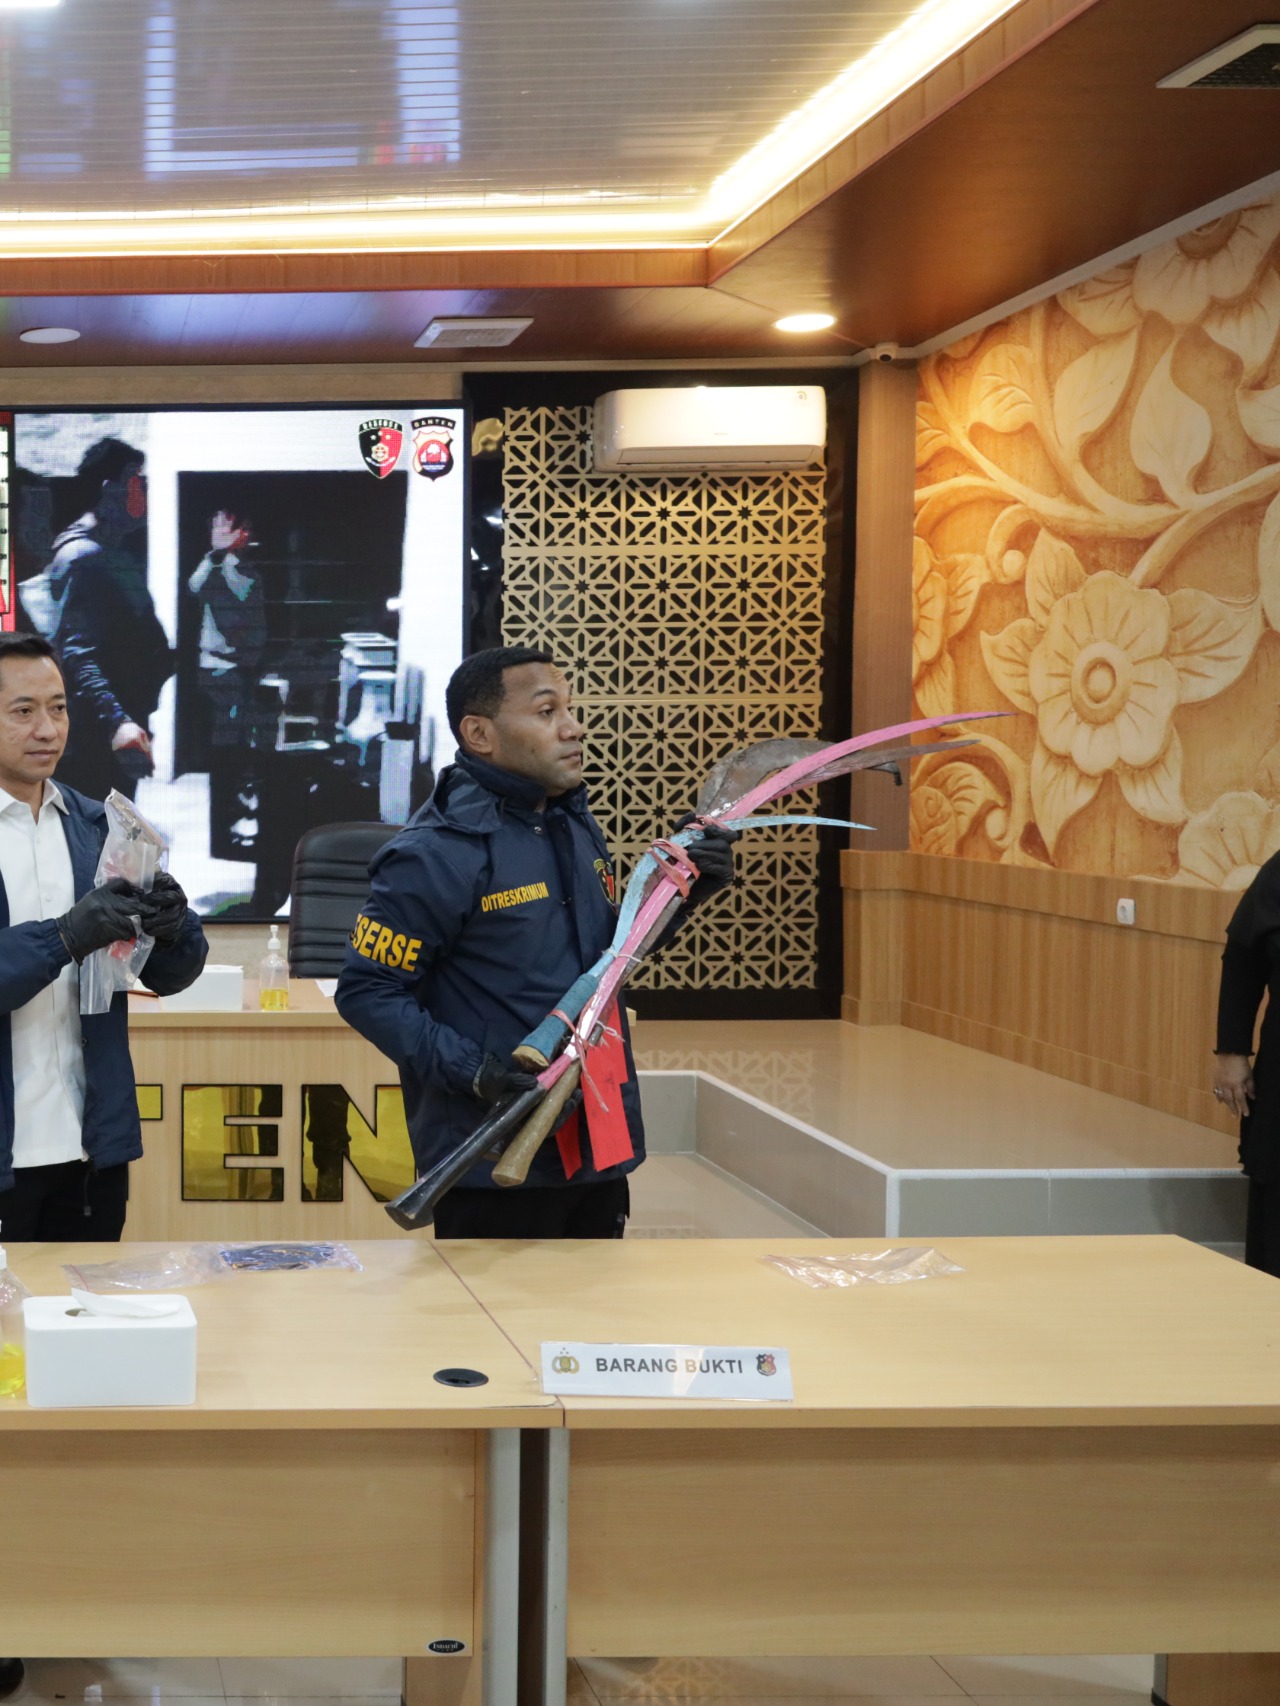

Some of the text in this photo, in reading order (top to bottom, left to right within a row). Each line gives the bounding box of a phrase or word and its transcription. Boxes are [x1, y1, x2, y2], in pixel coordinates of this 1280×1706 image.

[481, 881, 549, 912] DITRESKRIMUM
[595, 1358, 743, 1374] BARANG BUKTI
